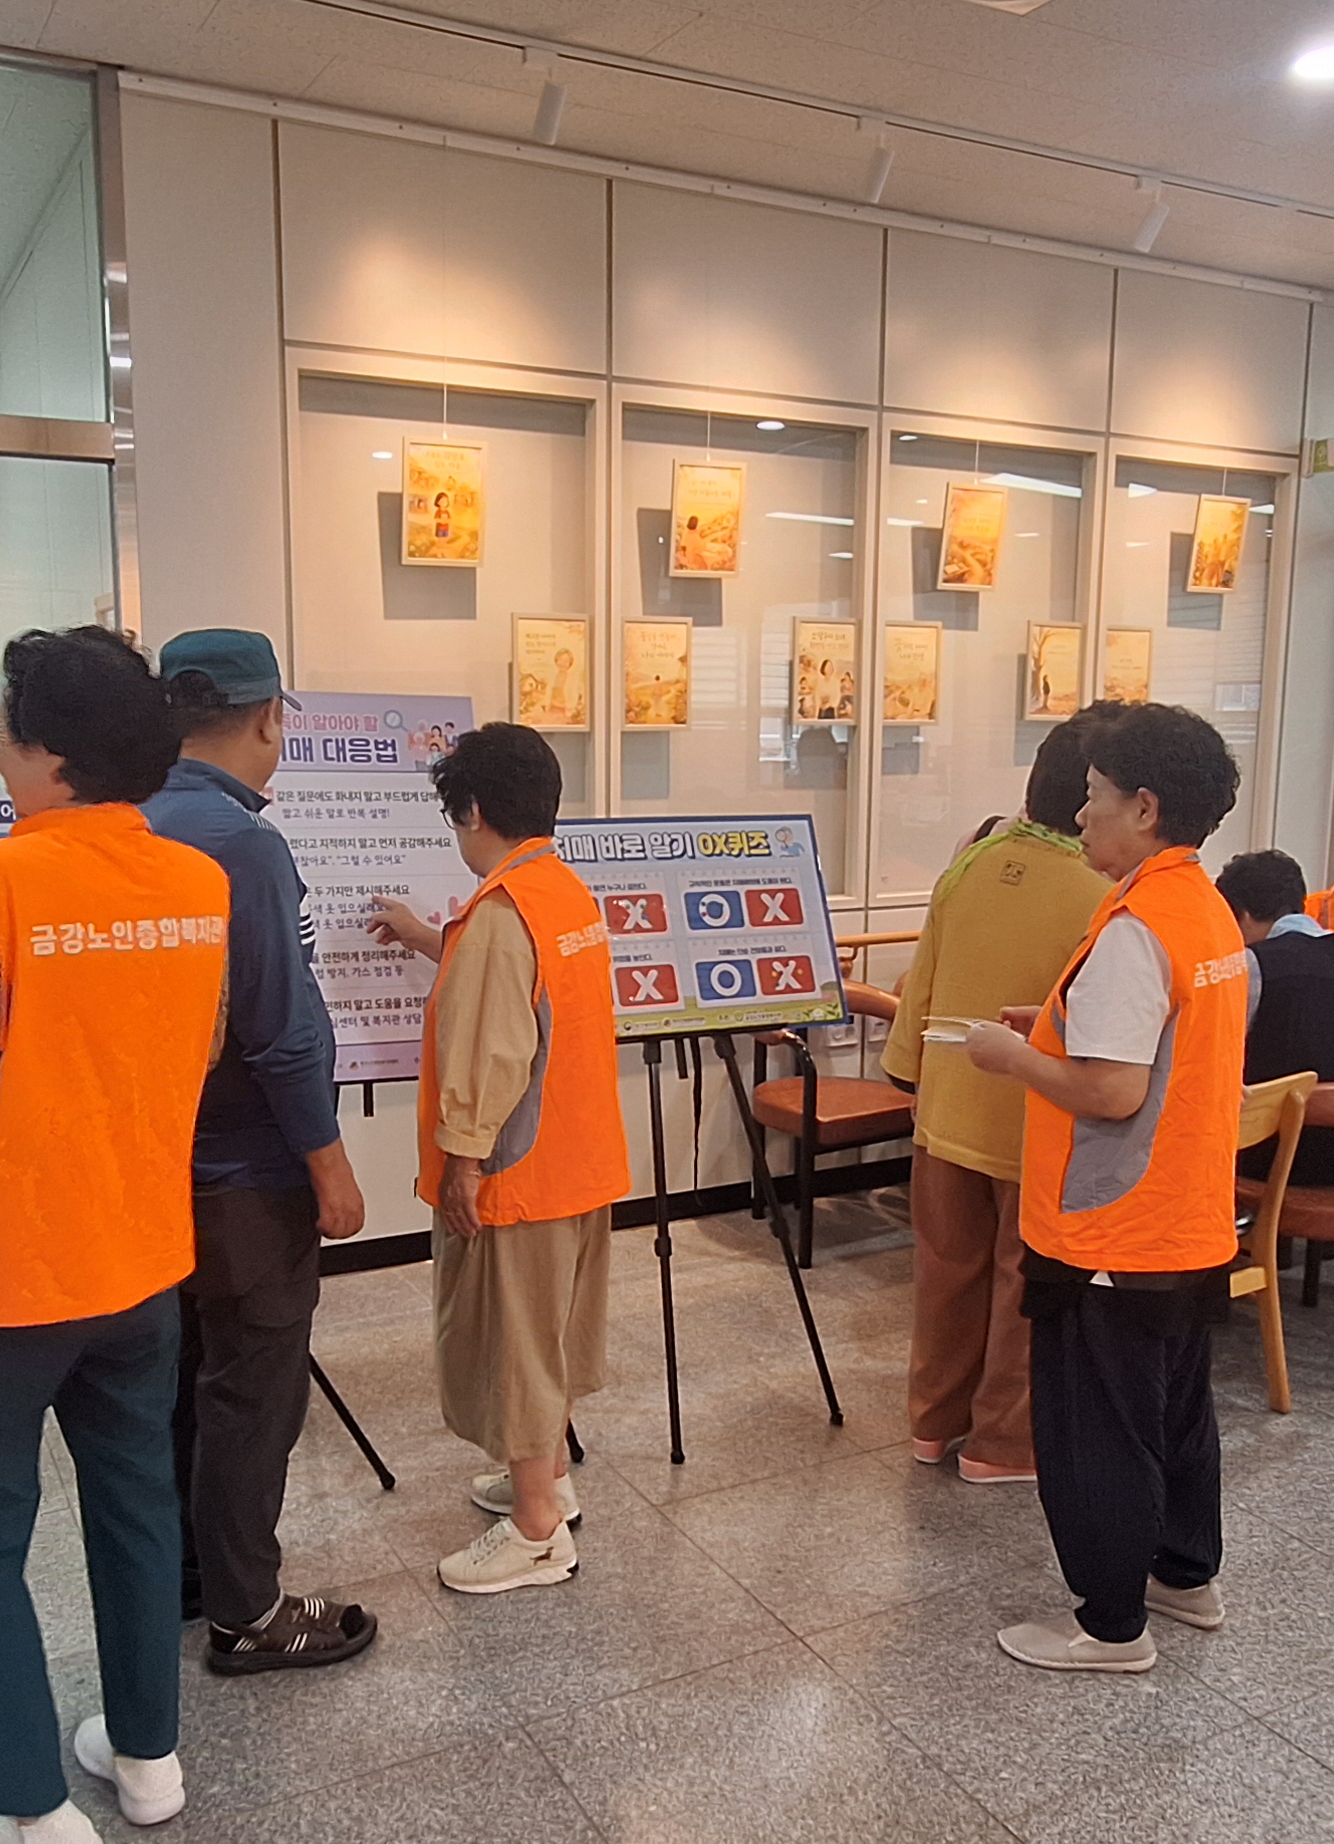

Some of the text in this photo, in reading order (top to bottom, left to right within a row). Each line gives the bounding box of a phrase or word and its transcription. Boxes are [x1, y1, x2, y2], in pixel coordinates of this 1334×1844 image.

[282, 713, 379, 732] 족이 알아야 할
[322, 737, 398, 763] 대응법
[289, 838, 317, 850] 렸다고
[319, 838, 357, 850] 지적하지
[379, 838, 397, 850] 먼저
[399, 837, 452, 849] 공감해주세요
[599, 833, 647, 860] 바로
[649, 831, 696, 859] 알기
[697, 831, 773, 857] OX퀴즈
[314, 886, 324, 896] 두
[326, 886, 353, 897] 가지만
[356, 885, 410, 896] 제시해주세요
[622, 898, 653, 930] X
[760, 892, 790, 922] X
[30, 915, 225, 956] 금강노인종합복지관
[322, 951, 359, 963] 안전하게
[361, 950, 416, 962] 정리해주세요
[352, 967, 371, 977] 가스
[772, 960, 800, 992] X
[631, 969, 664, 1001] X
[325, 1001, 352, 1012] 민하지
[373, 1015, 400, 1026] 복지관
[403, 1014, 422, 1025] 상담
